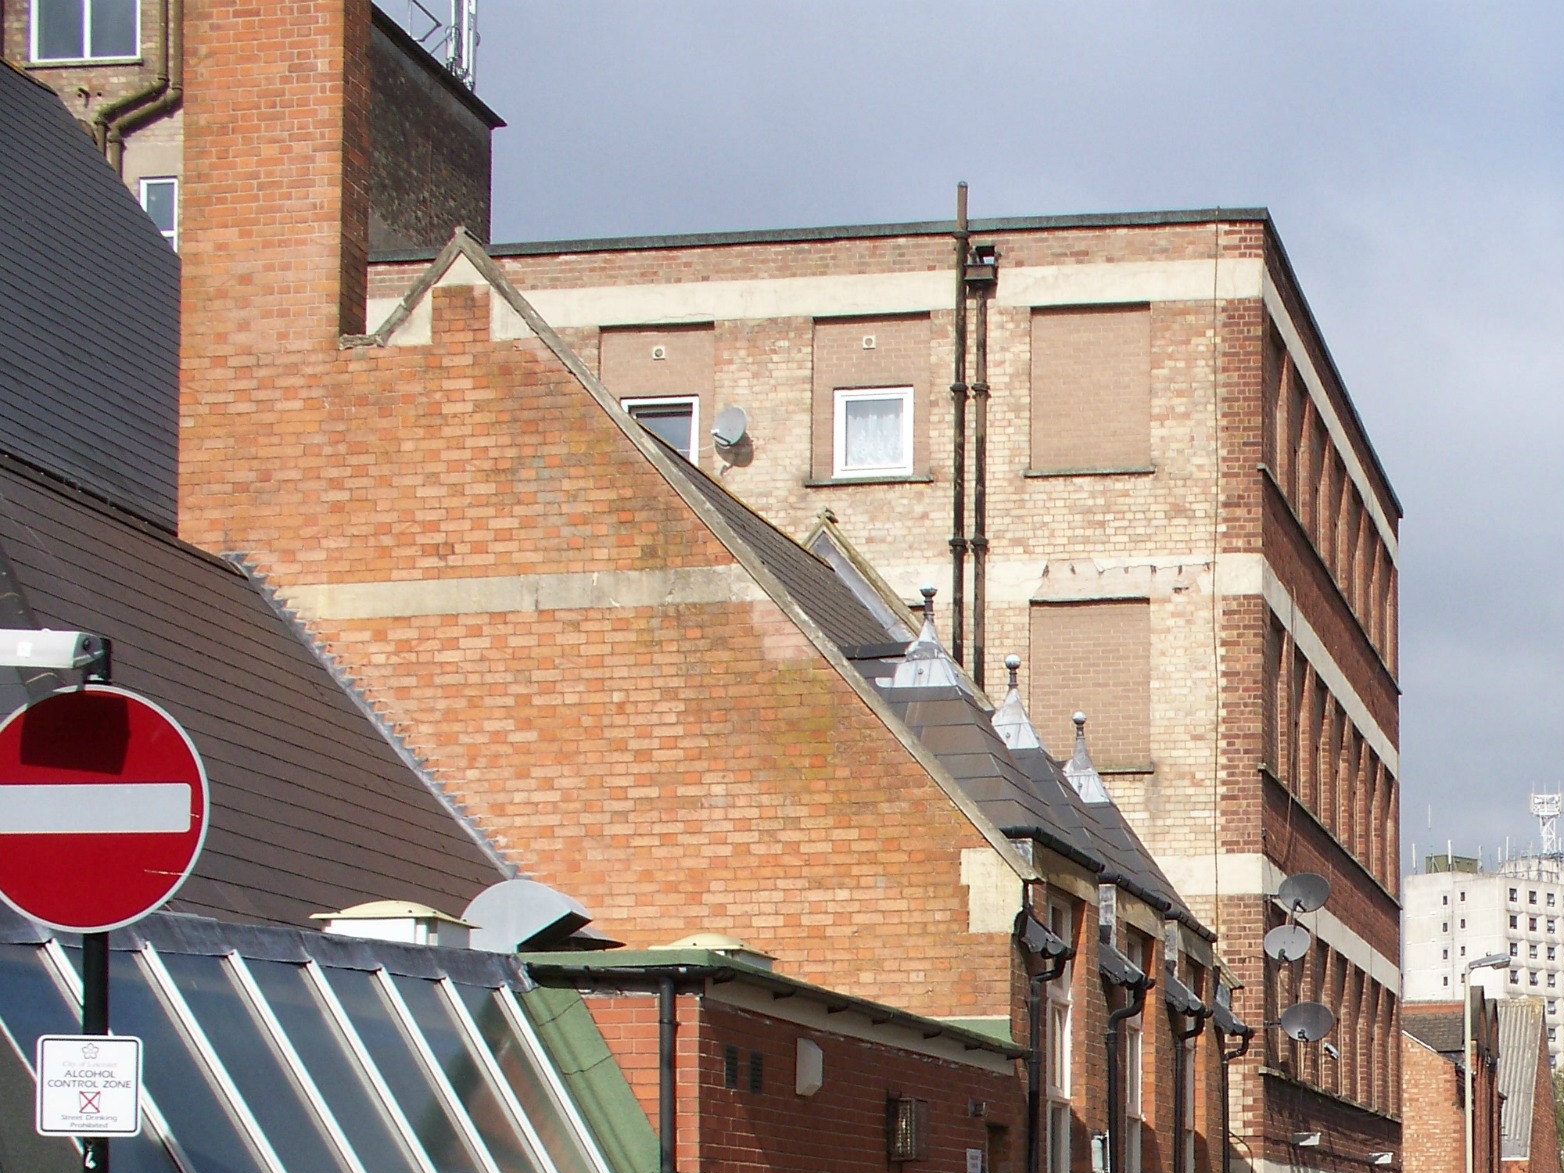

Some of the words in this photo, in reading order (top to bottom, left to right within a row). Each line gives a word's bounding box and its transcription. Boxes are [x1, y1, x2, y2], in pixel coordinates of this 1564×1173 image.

[63, 1069, 116, 1079] ALCOHOL
[47, 1079, 99, 1088] CONTROL
[102, 1080, 132, 1089] ZONE
[85, 1114, 118, 1122] Drinking
